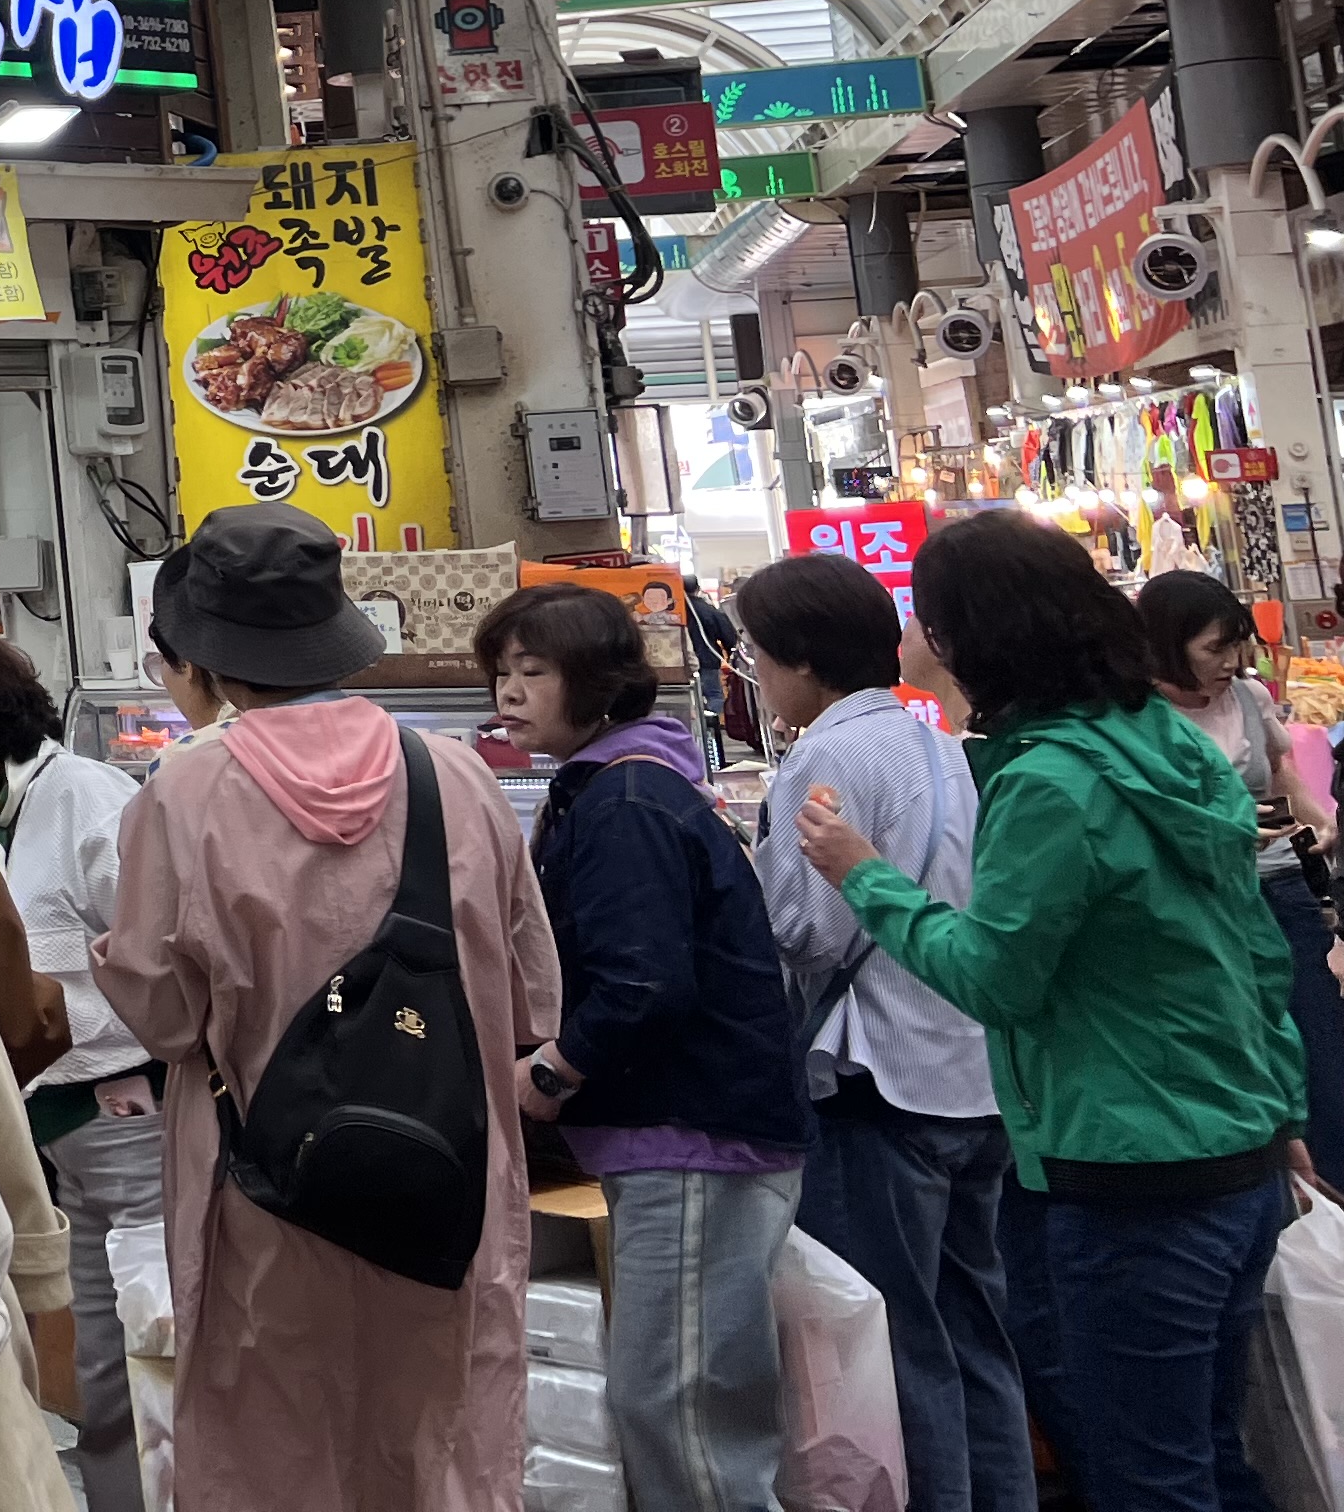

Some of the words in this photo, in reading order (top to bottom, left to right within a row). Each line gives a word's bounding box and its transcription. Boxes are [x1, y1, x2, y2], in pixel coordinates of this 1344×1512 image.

[123, 35, 190, 52] 64-732-6210
[653, 140, 706, 159] 호스릴
[263, 158, 378, 210] 돼지
[655, 159, 708, 178] 소화전
[279, 216, 401, 288] 족발
[238, 426, 390, 507] 순대
